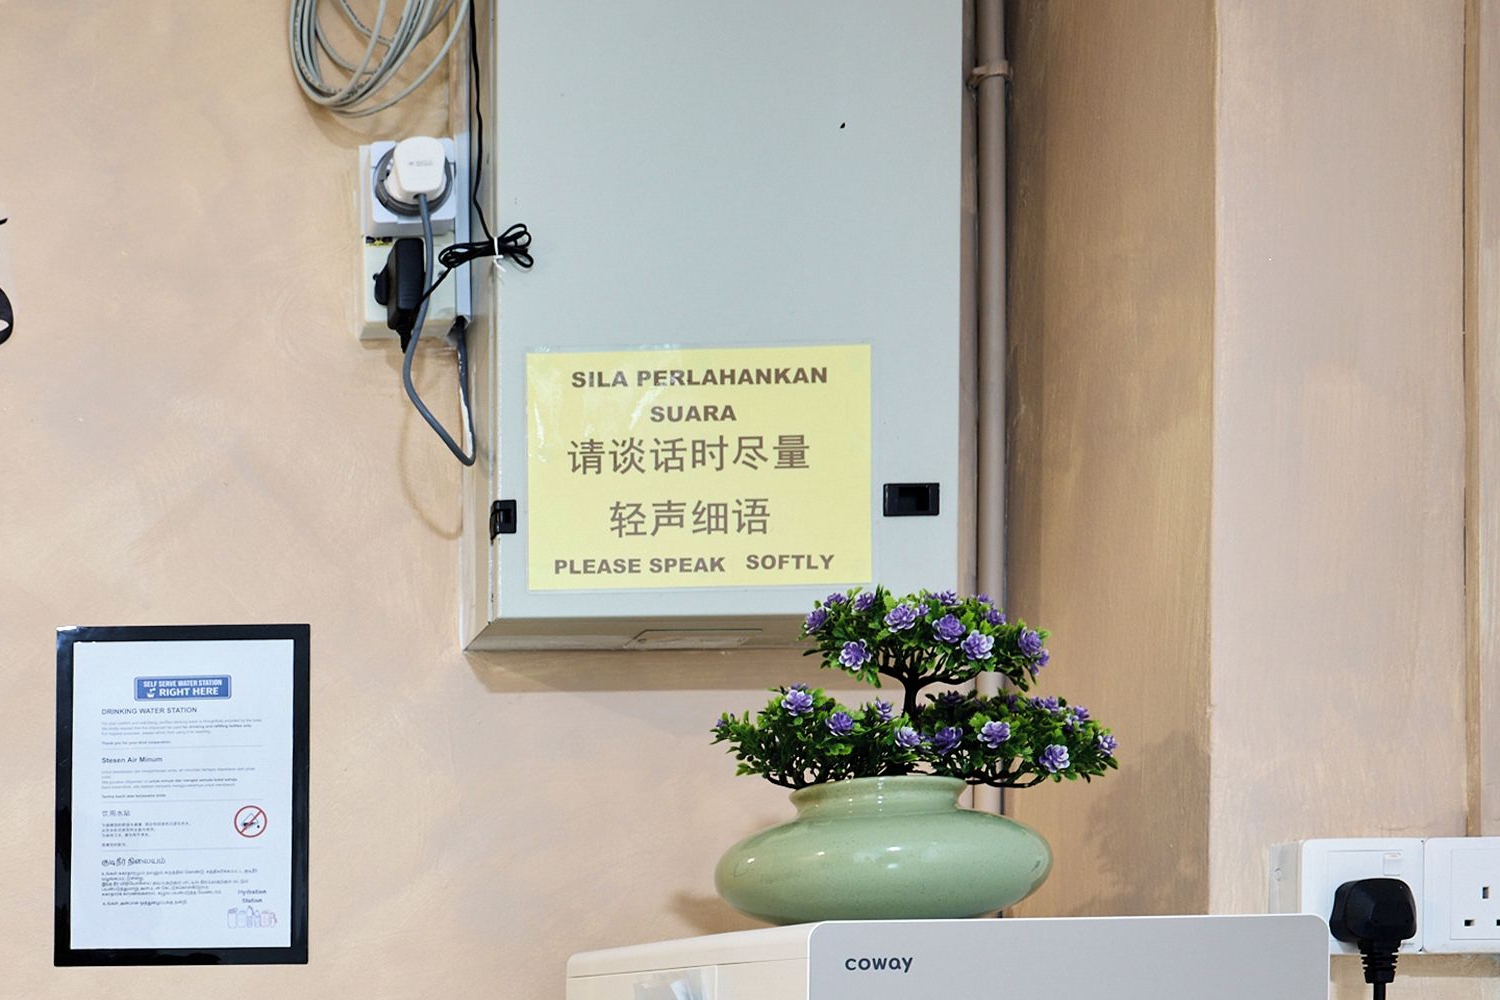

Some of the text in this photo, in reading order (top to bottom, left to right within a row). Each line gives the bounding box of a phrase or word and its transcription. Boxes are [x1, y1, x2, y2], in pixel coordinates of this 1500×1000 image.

[572, 367, 827, 388] SILA PERLAHANKAN
[651, 405, 736, 422] SUARA
[568, 435, 809, 475] 请谈话时尽量
[610, 498, 770, 538] 轻声细语
[555, 555, 834, 574] PLEASE SPEAK SOFTLY
[143, 680, 156, 688] SELF
[159, 687, 218, 696] RIGHT HERE
[102, 707, 137, 715] DRINKING
[845, 957, 913, 973] coway
